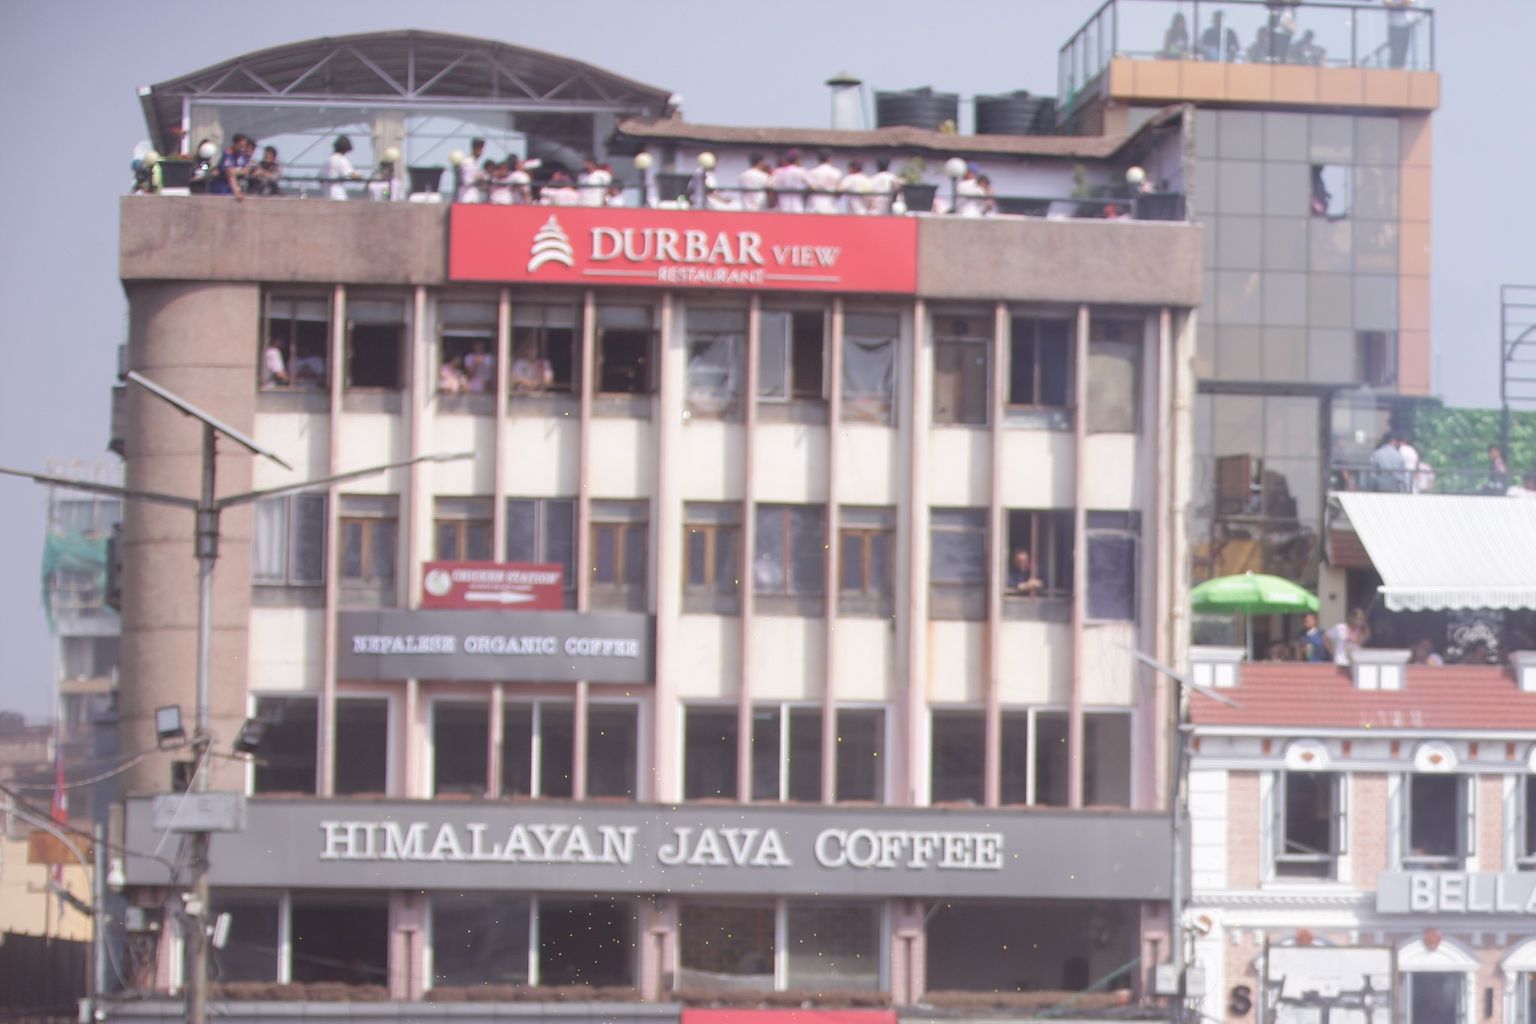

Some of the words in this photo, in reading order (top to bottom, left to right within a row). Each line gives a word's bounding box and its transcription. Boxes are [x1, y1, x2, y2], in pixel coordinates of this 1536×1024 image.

[590, 226, 766, 266] DURBAR
[771, 244, 842, 267] VIEW
[657, 265, 766, 285] RESTAURANT
[352, 634, 456, 655] NEPALESE
[463, 635, 557, 656] ORGANIC
[564, 637, 640, 658] COFFEE
[319, 820, 637, 865] HIMALAYAN
[657, 826, 792, 868] JAVA
[813, 828, 1005, 871] COFFEE
